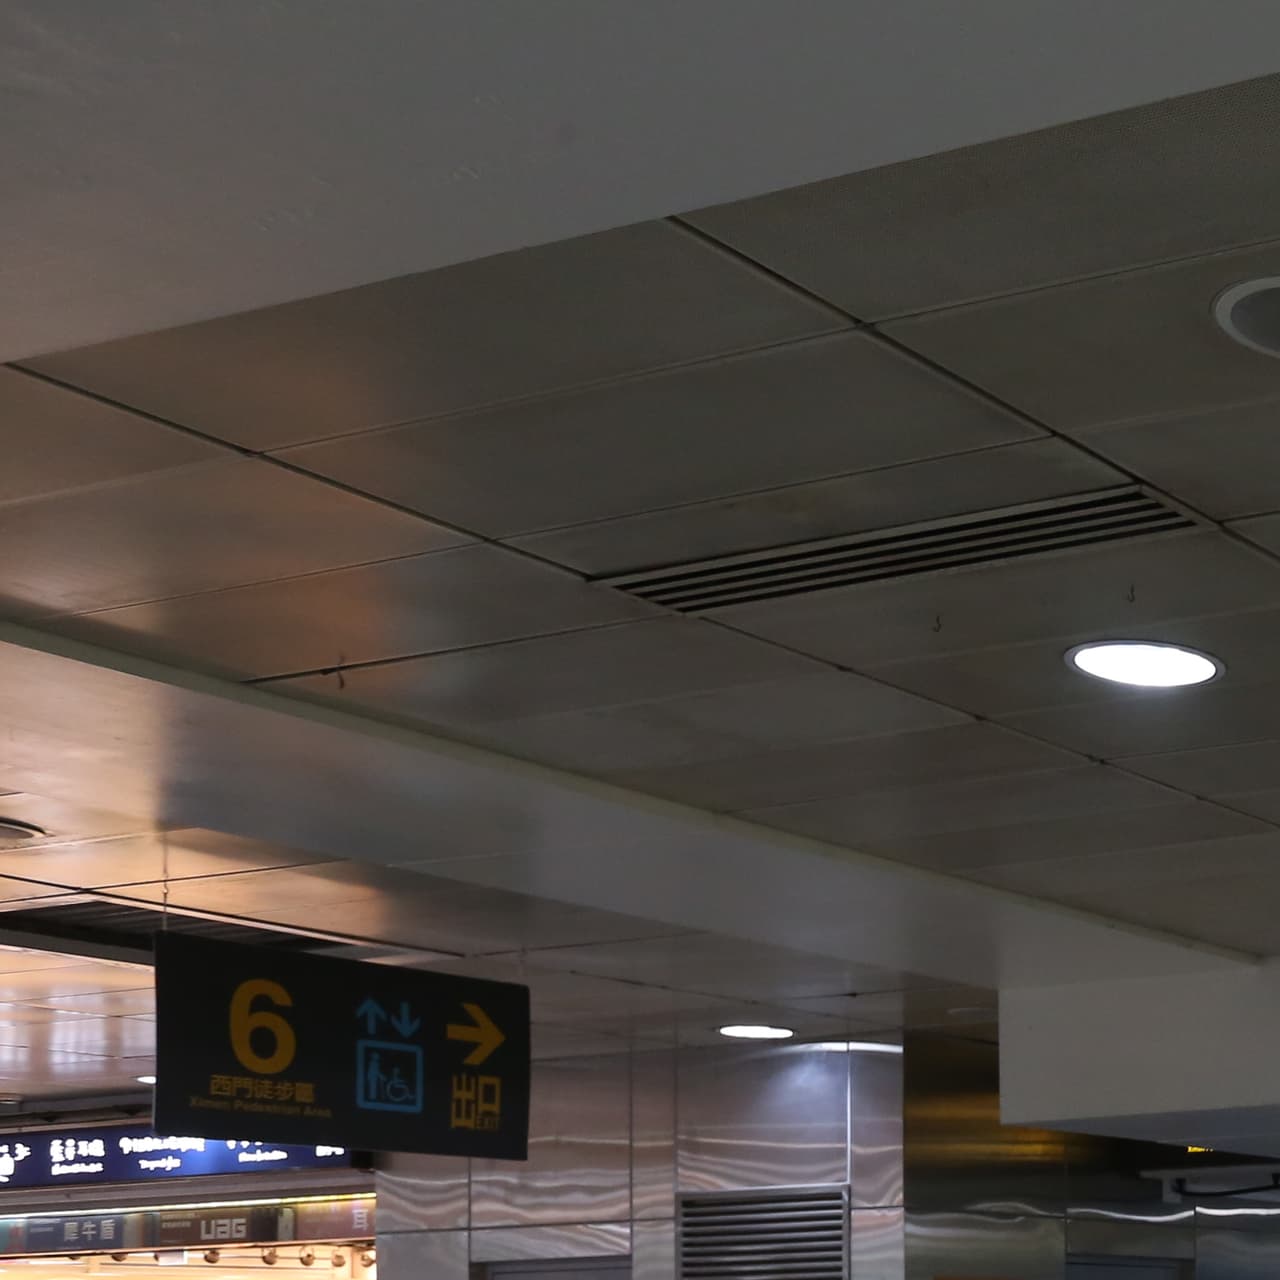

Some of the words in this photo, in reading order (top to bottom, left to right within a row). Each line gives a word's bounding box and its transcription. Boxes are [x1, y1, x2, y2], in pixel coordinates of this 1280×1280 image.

[229, 978, 296, 1074] 6
[210, 1074, 316, 1104] 西門徒步區
[451, 1073, 502, 1129] 出口
